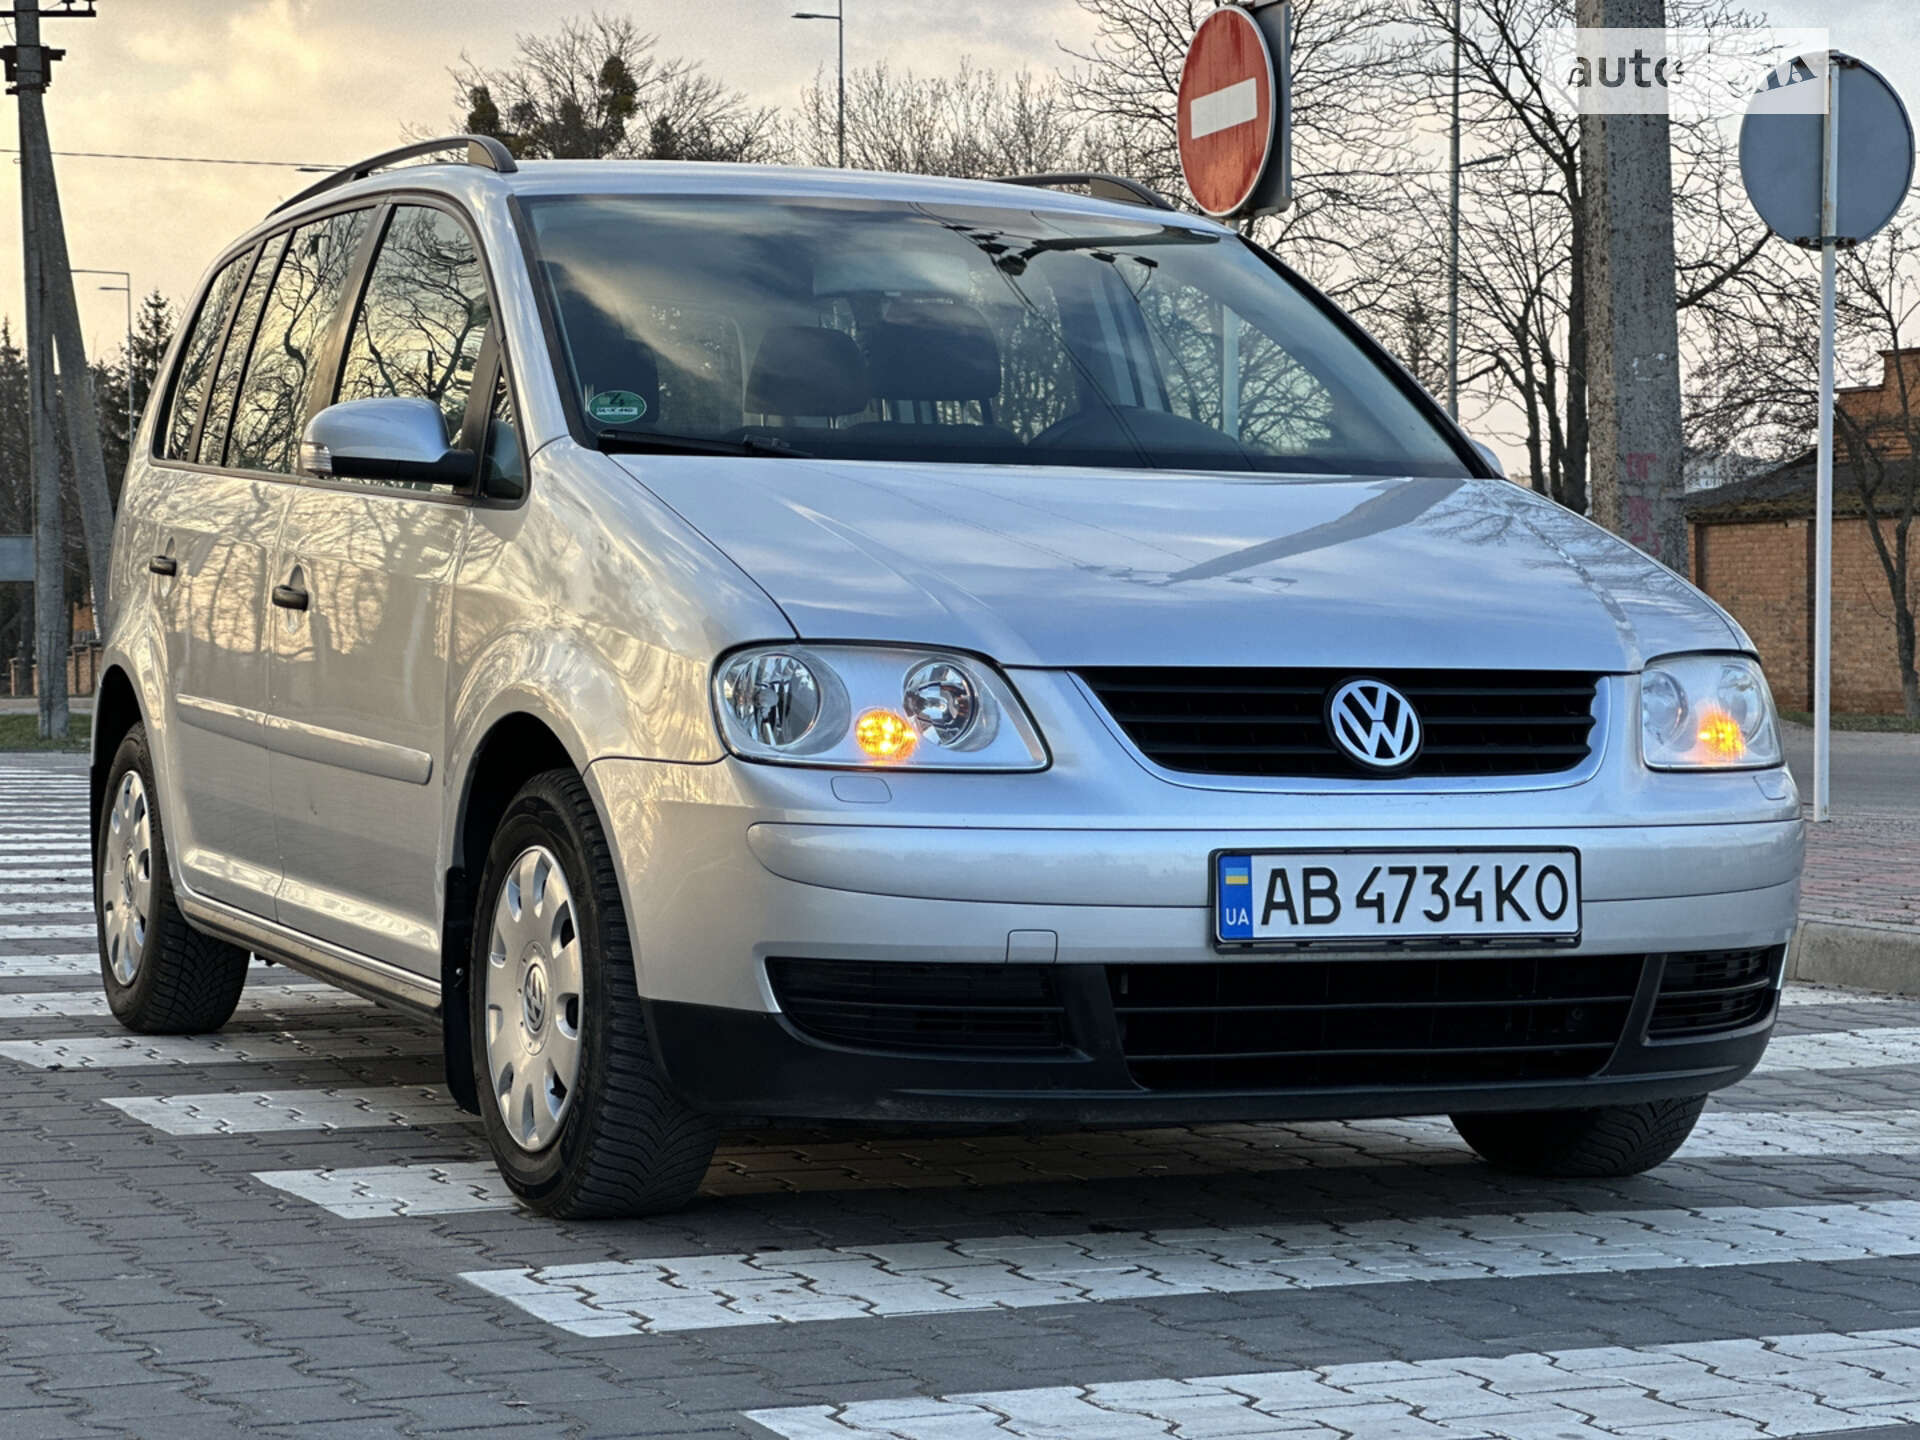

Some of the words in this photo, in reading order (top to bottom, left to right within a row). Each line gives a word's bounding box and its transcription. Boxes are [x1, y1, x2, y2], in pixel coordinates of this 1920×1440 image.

[1331, 680, 1420, 766] VW
[1225, 907, 1250, 927] UA
[1260, 866, 1342, 926] AB
[1355, 864, 1484, 924] 4734
[1495, 863, 1569, 923] KO
